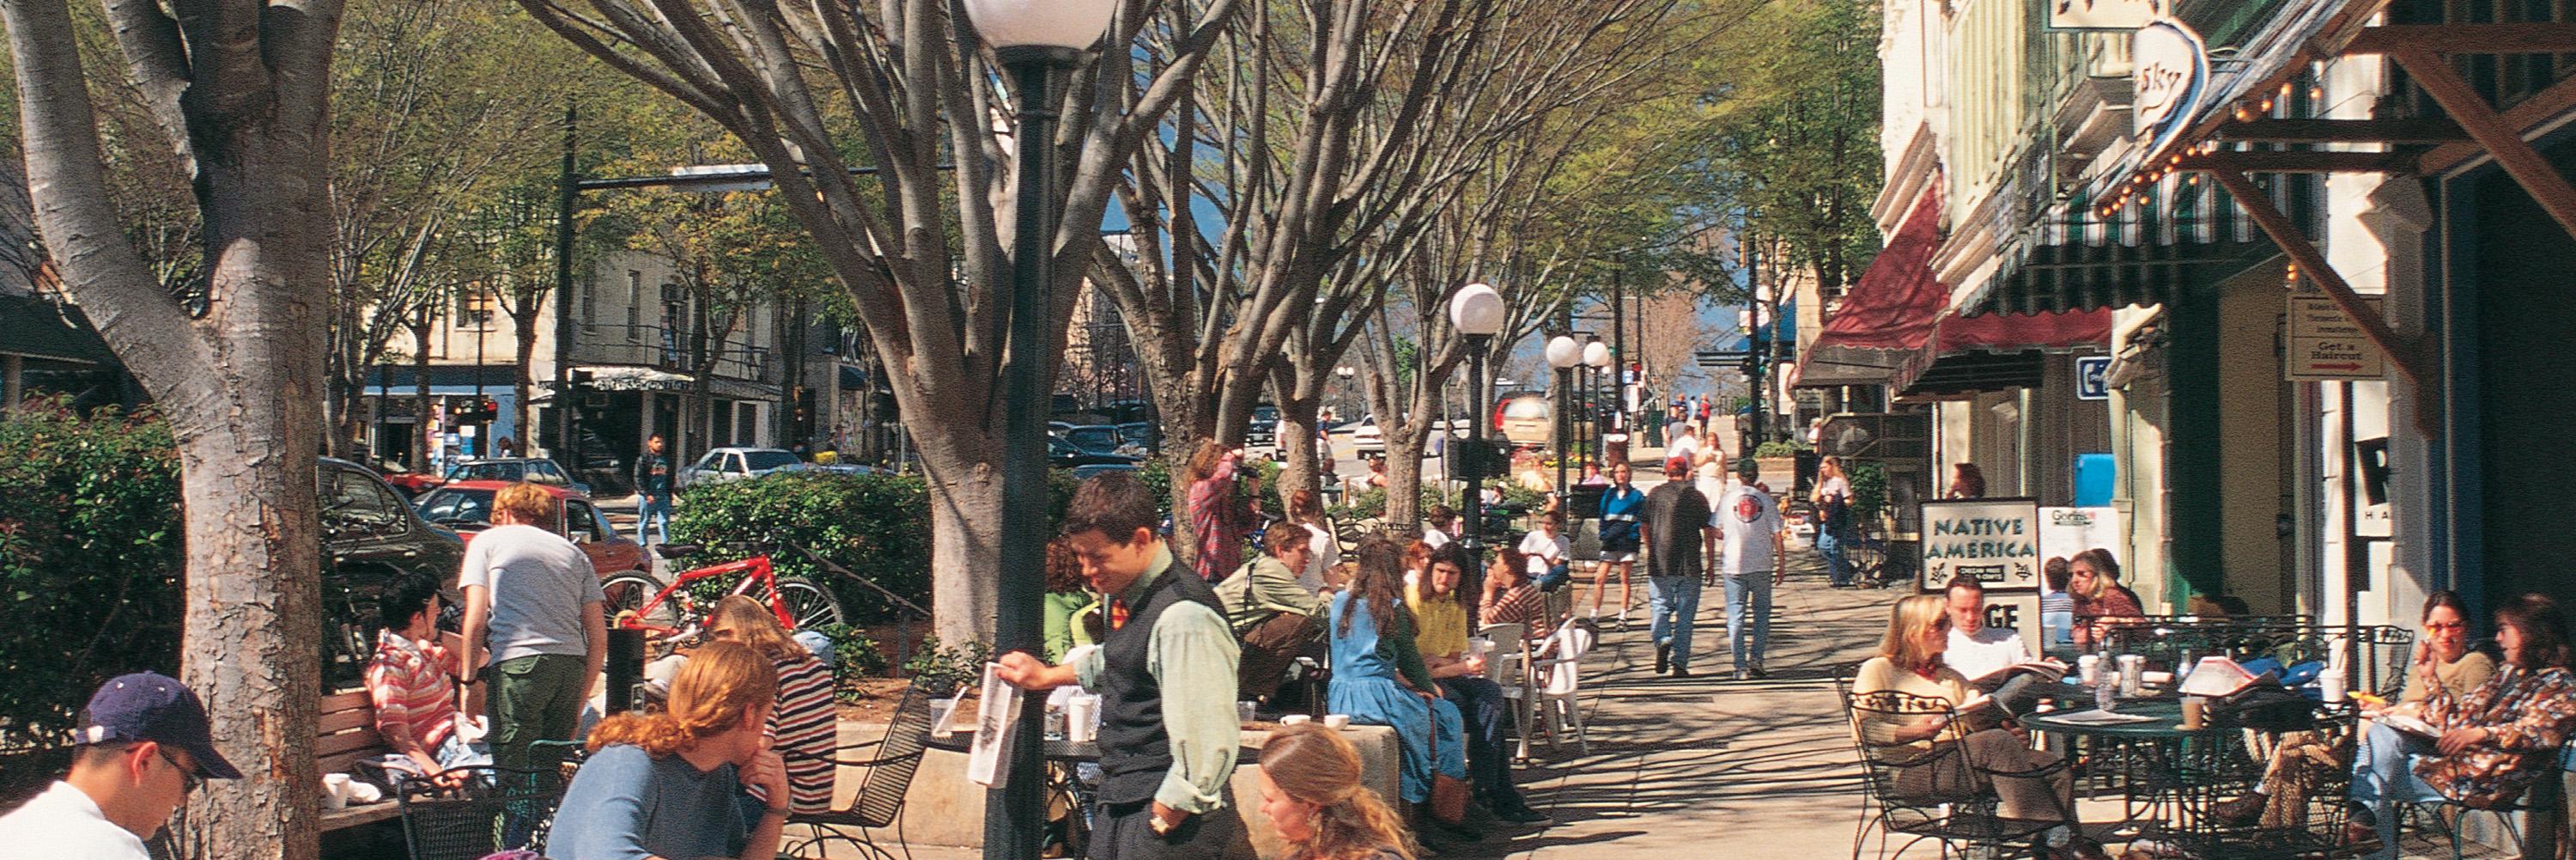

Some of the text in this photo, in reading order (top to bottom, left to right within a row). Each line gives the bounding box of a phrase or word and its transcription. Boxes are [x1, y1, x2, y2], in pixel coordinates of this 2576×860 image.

[2135, 62, 2182, 116] sky
[2311, 351, 2362, 359] Haircut
[2318, 342, 2342, 351] Get
[1934, 518, 2022, 535] NATIVE
[1924, 541, 2034, 558] AMERICA
[1984, 603, 2018, 632] GE
